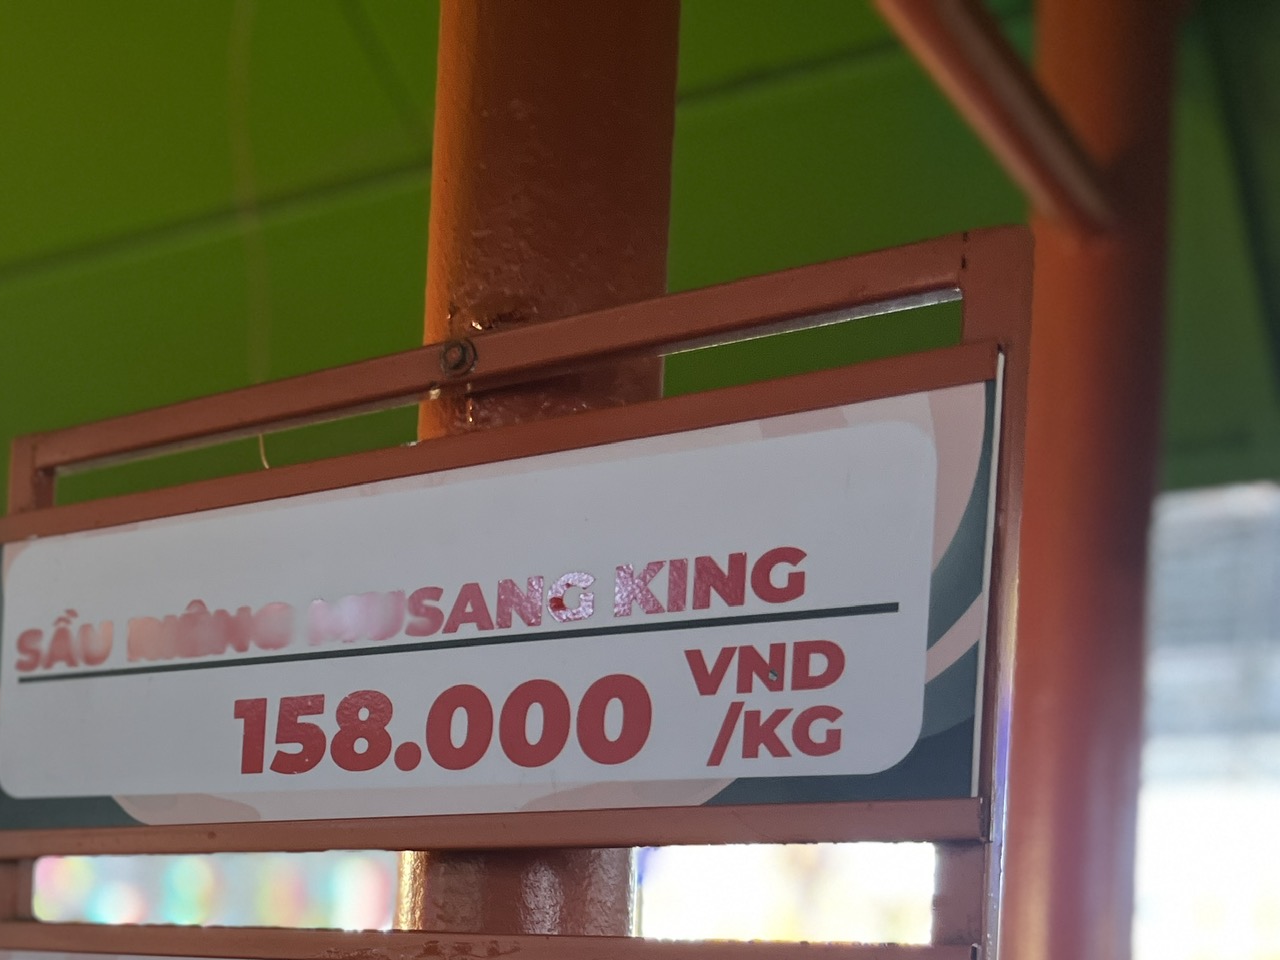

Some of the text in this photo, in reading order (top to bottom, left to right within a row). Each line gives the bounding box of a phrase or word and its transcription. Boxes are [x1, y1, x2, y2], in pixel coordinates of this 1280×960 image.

[16, 609, 114, 672] SẦU
[614, 546, 808, 618] KING
[684, 639, 846, 696] VND
[233, 673, 653, 775] 158.000
[706, 701, 843, 767] /KG
